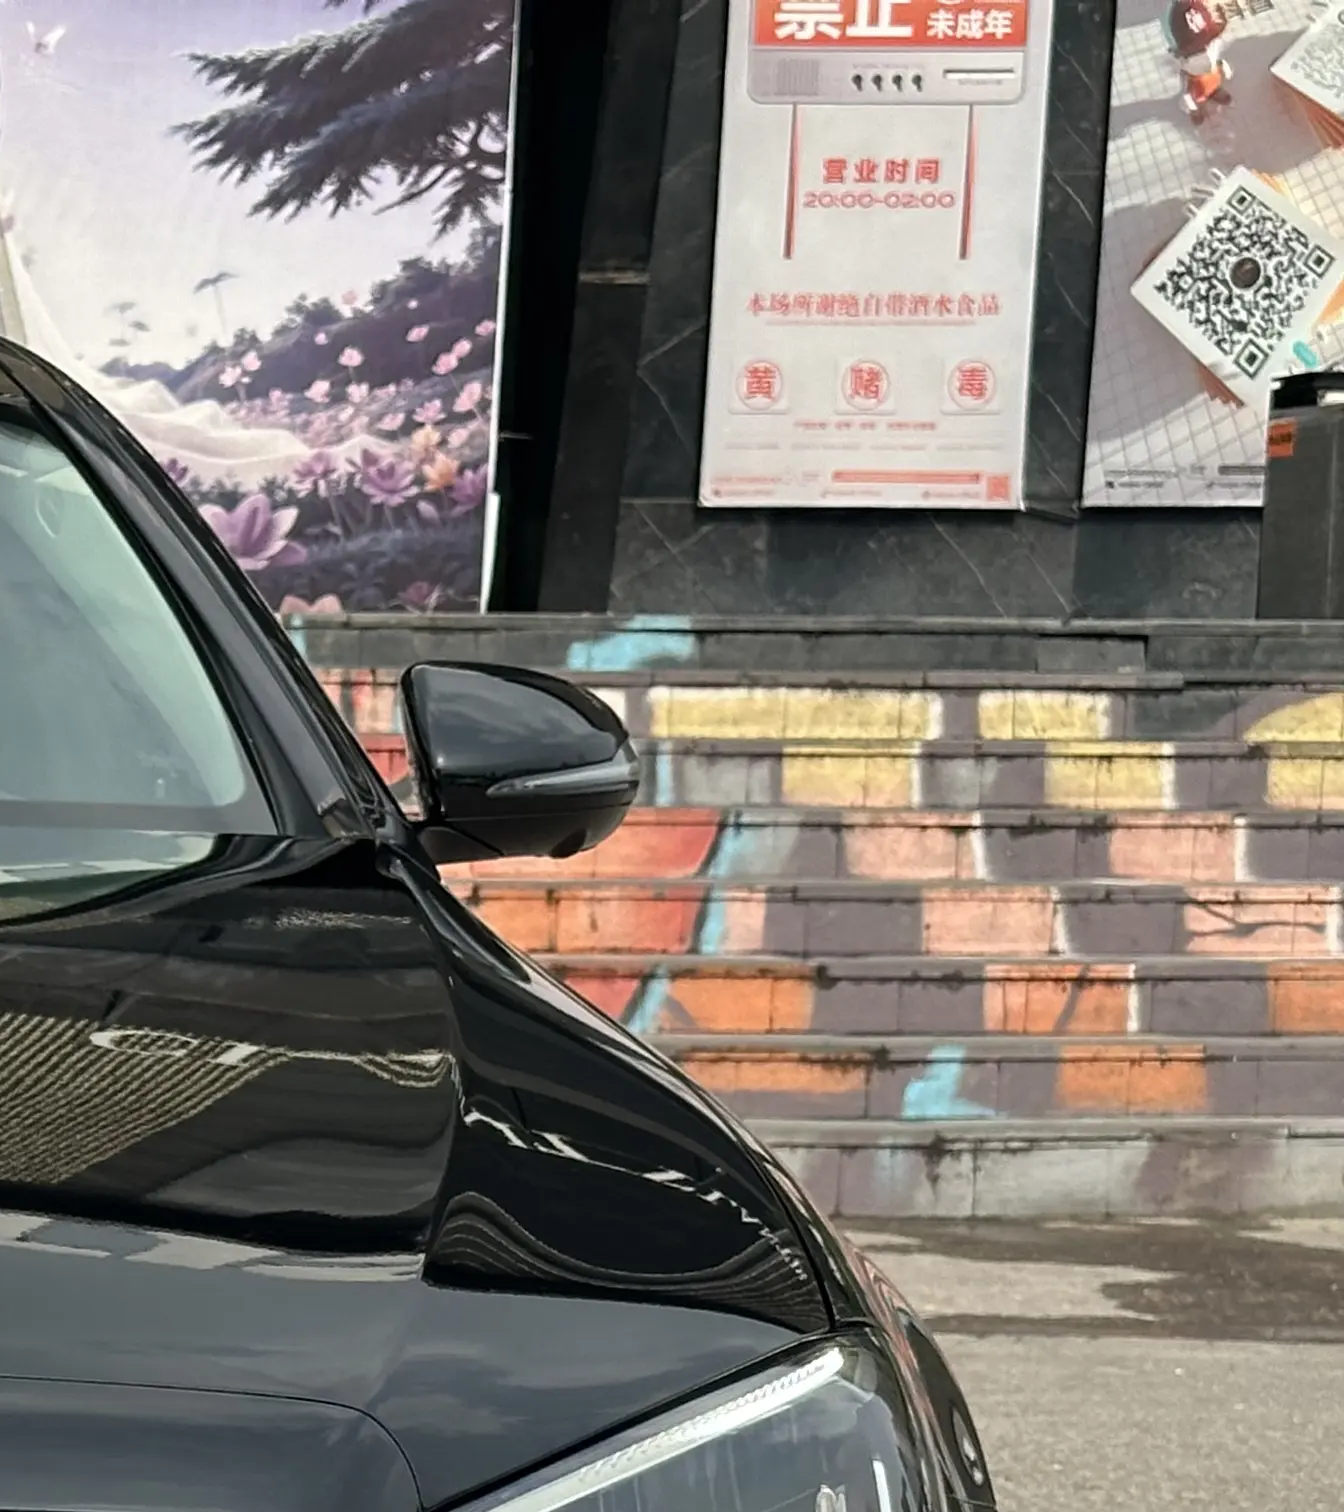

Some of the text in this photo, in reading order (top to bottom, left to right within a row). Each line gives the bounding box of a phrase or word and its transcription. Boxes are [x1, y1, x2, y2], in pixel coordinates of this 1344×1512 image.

[926, 9, 1014, 40] 未成年
[823, 157, 940, 184] 营业时间
[747, 292, 1002, 318] 本场所谢绝自带酒水食品
[743, 366, 990, 401] 黄 赌 毒
